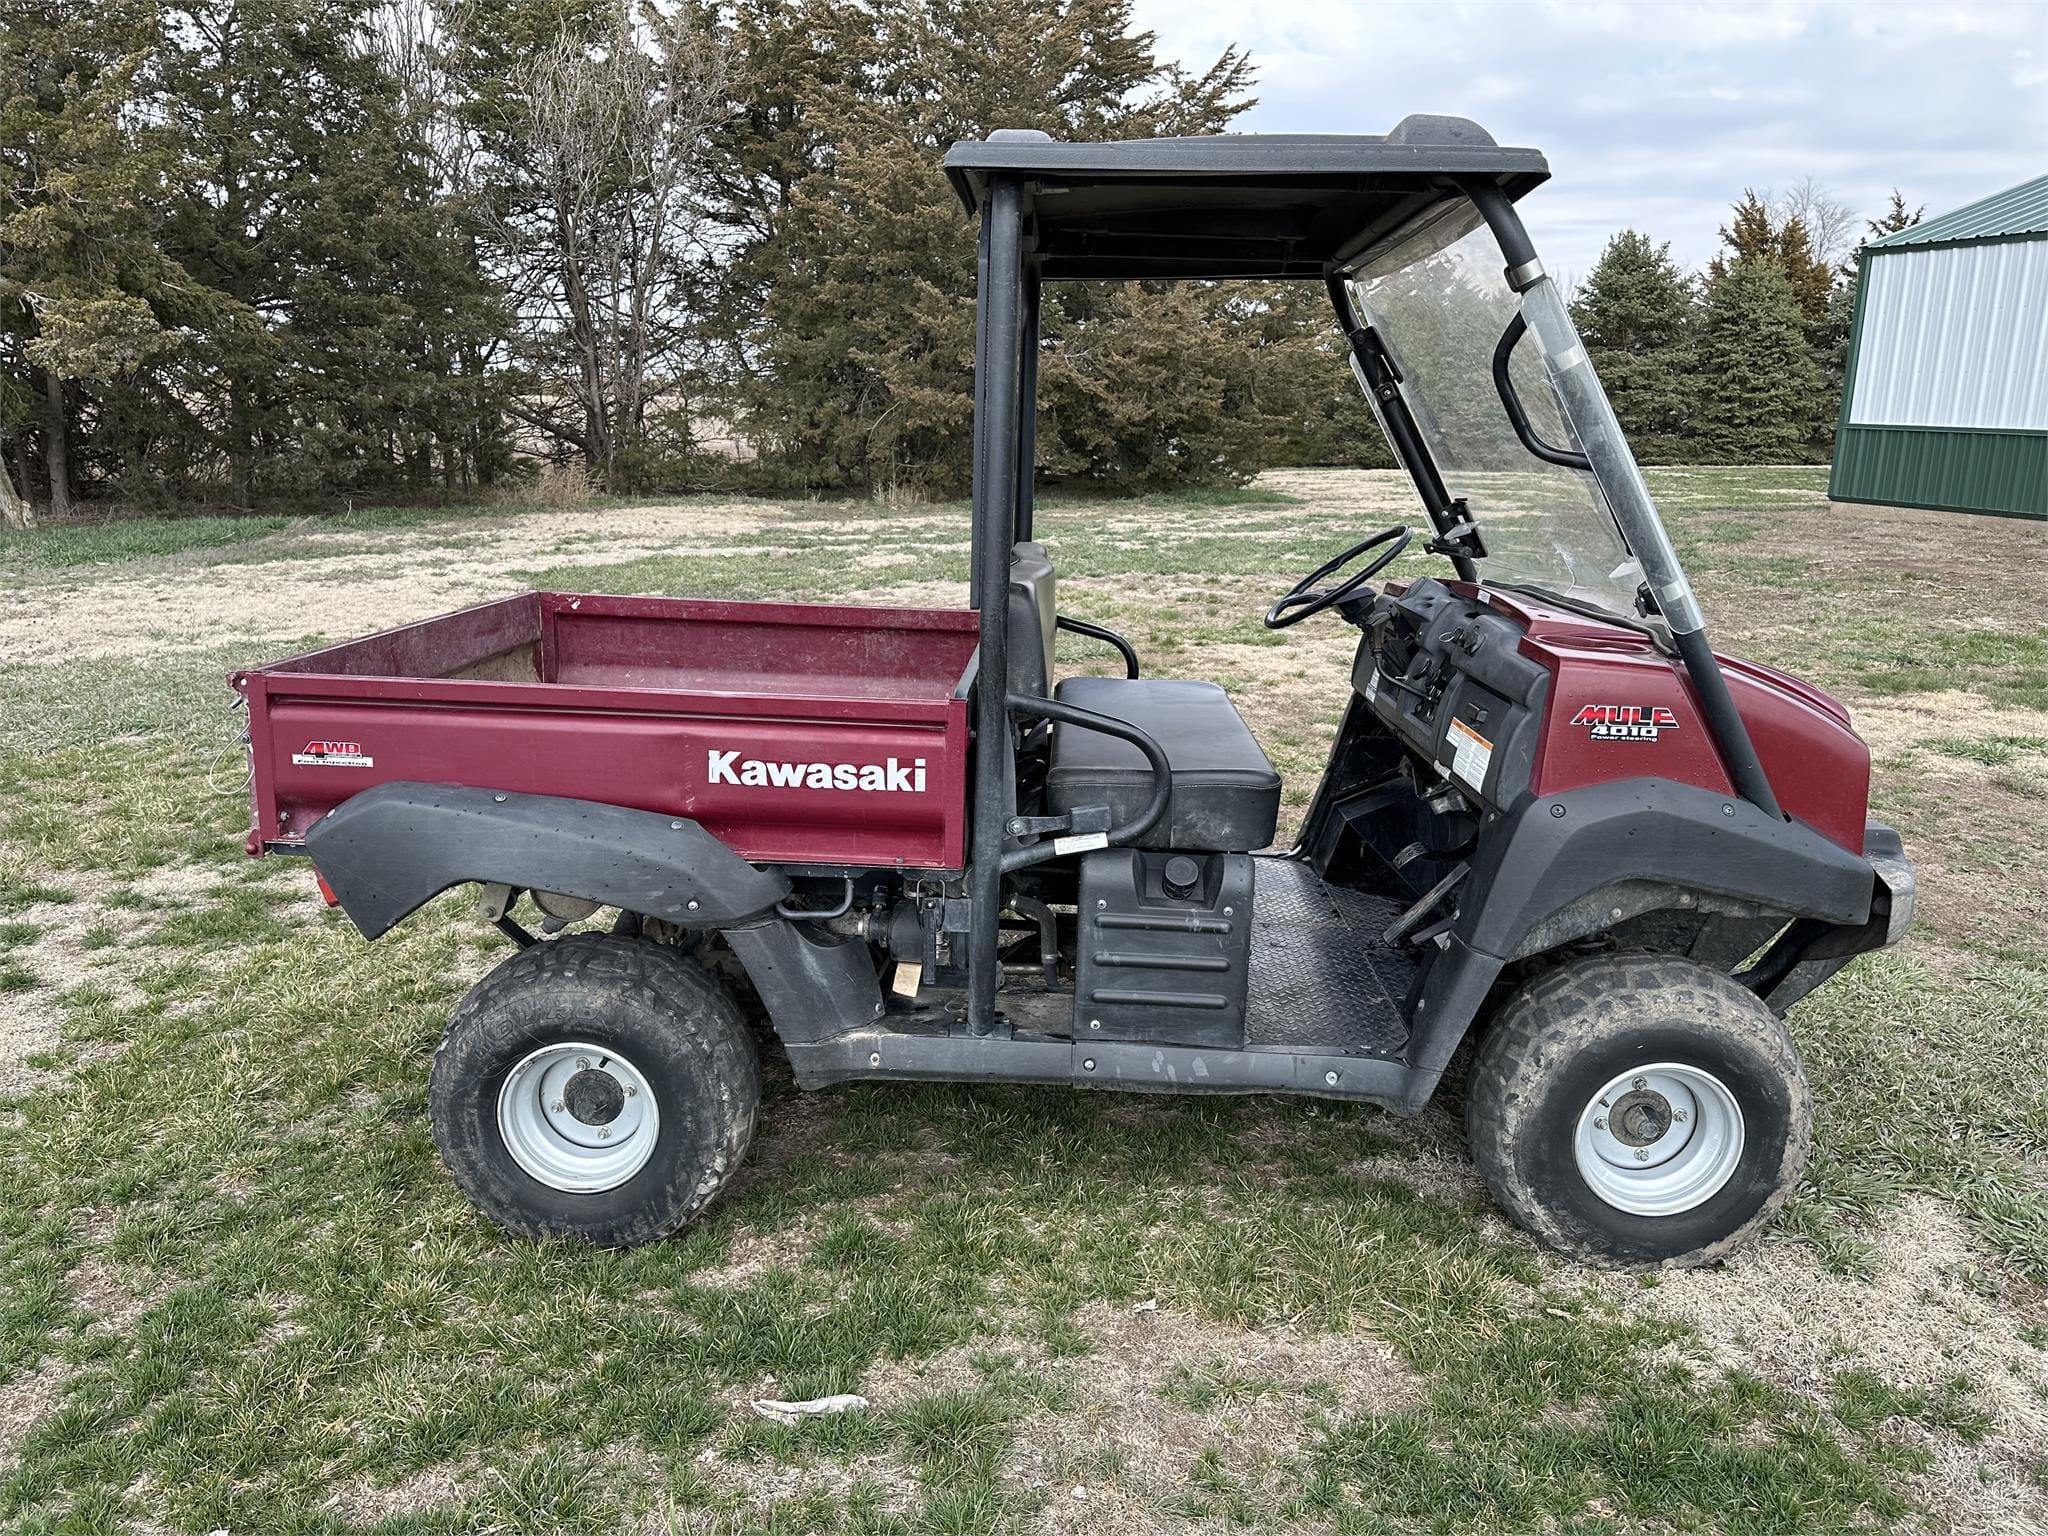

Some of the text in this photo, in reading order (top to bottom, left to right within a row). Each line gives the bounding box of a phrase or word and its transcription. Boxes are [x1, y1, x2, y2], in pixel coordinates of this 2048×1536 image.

[1570, 705, 1680, 728] MULE
[1590, 726, 1658, 737] 4010
[1621, 735, 1659, 743] steering
[302, 740, 361, 758] 4WD
[708, 750, 926, 793] Kawasaki
